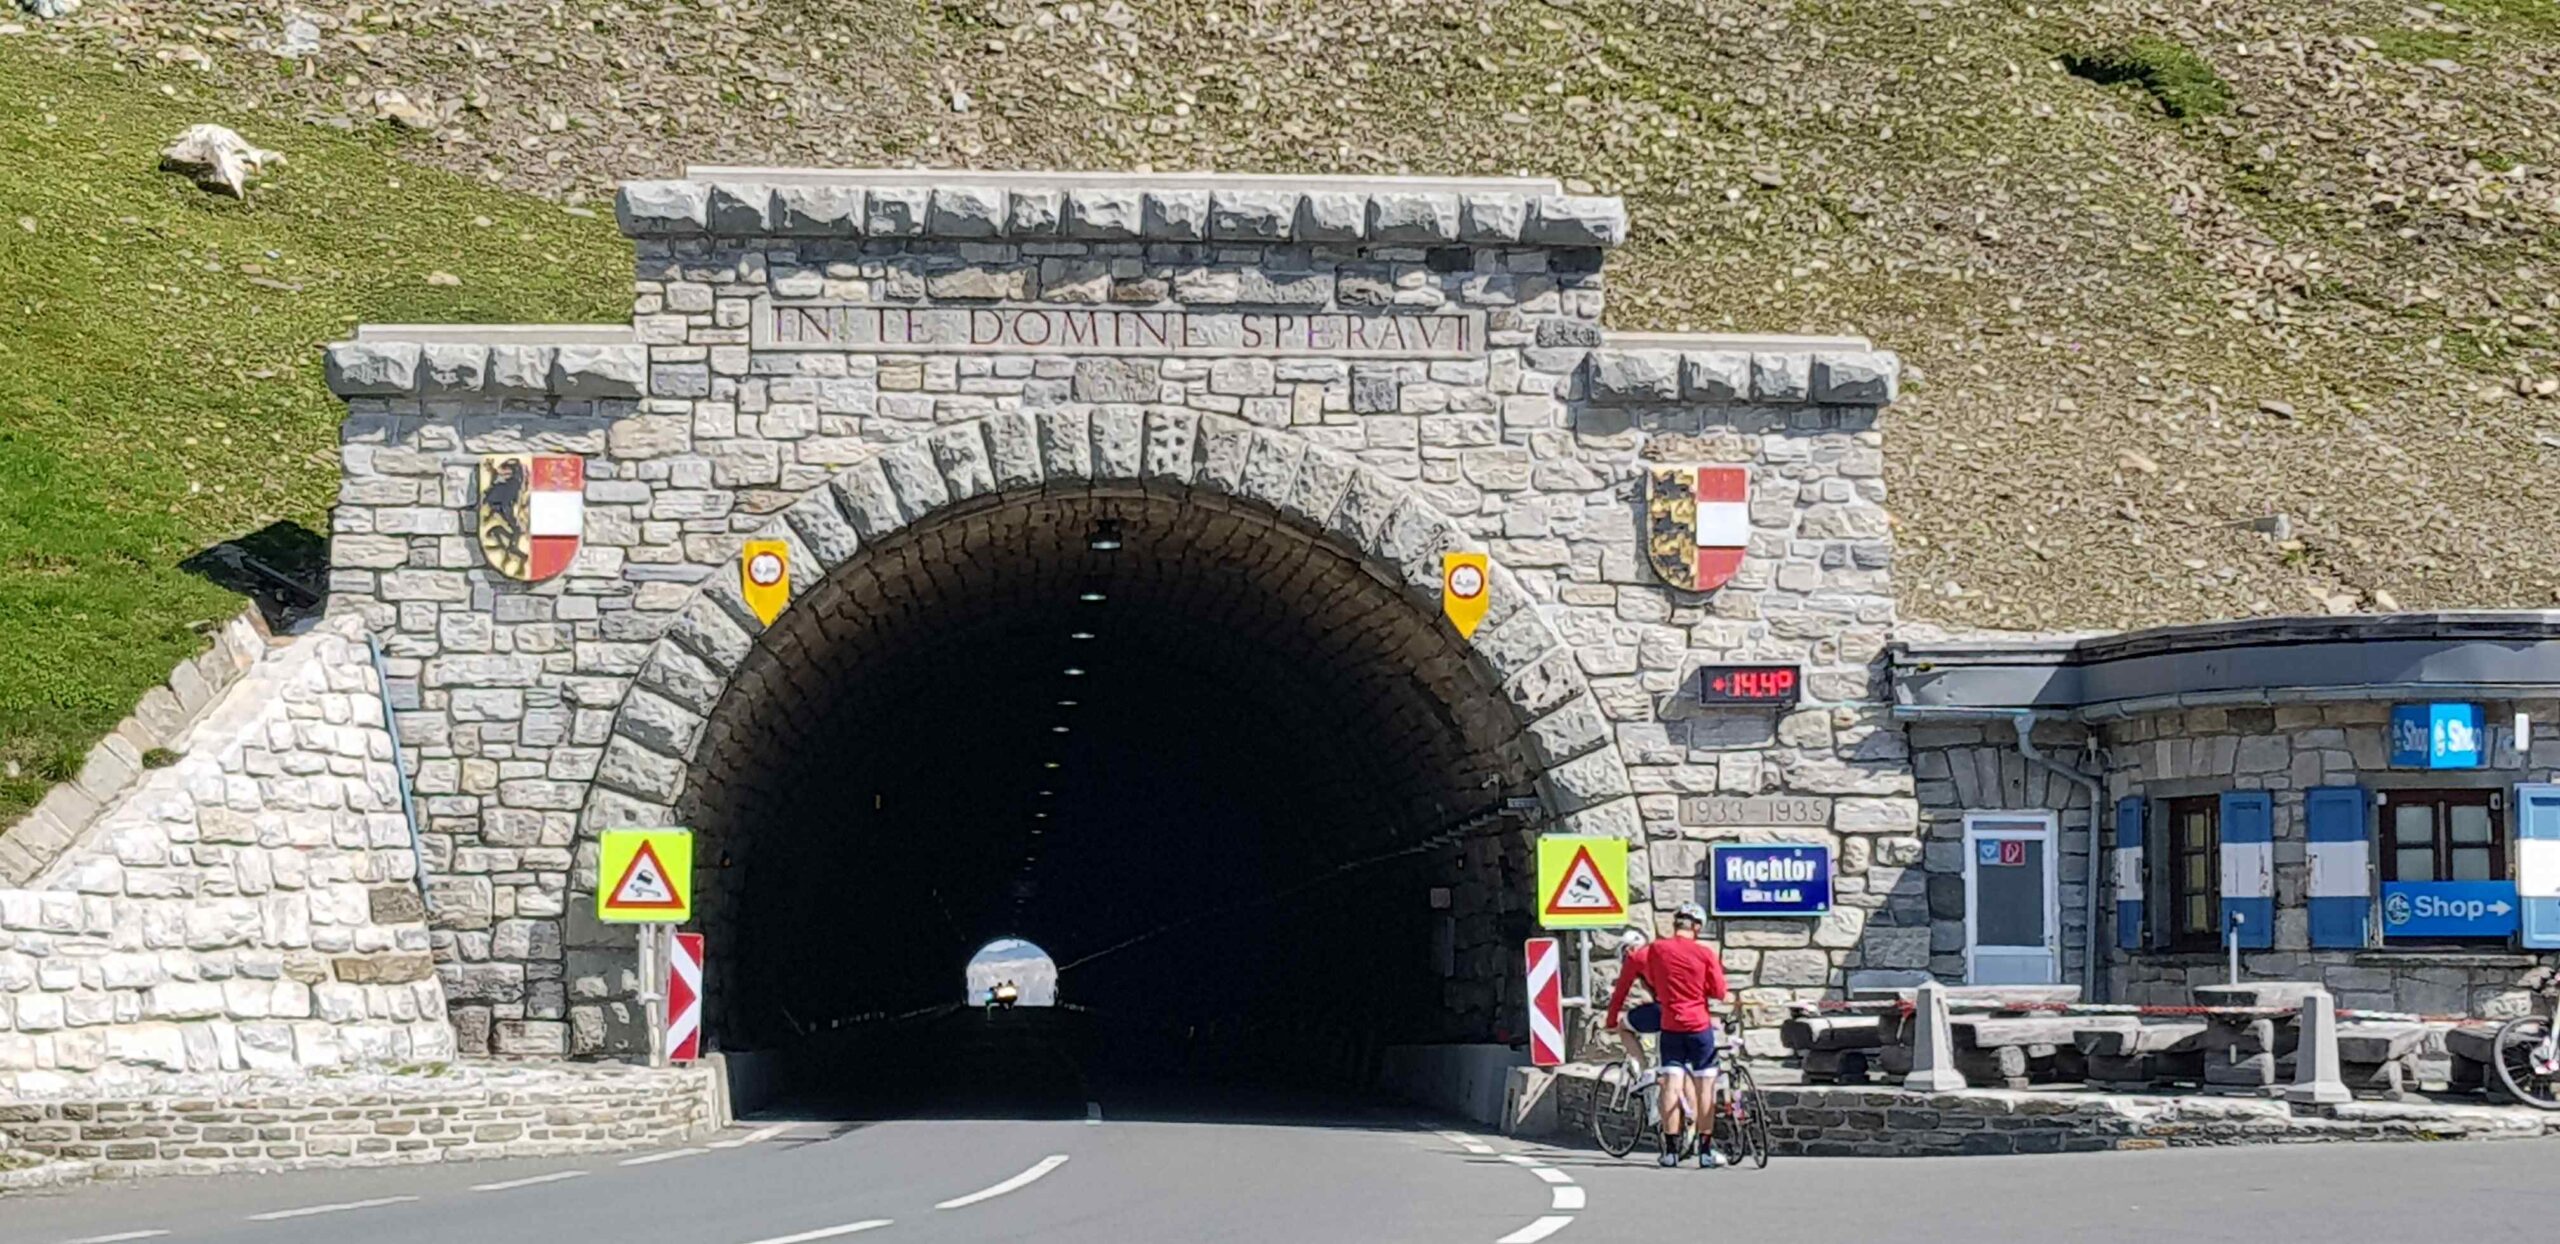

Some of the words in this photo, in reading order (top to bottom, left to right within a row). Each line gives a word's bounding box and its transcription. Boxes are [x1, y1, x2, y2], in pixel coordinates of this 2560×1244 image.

[774, 307, 831, 343] IN
[970, 308, 1200, 348] DOMINE
[1241, 312, 1471, 351] SPERAVI
[1725, 856, 1817, 882] Hochtor
[2414, 895, 2484, 922] Shop
